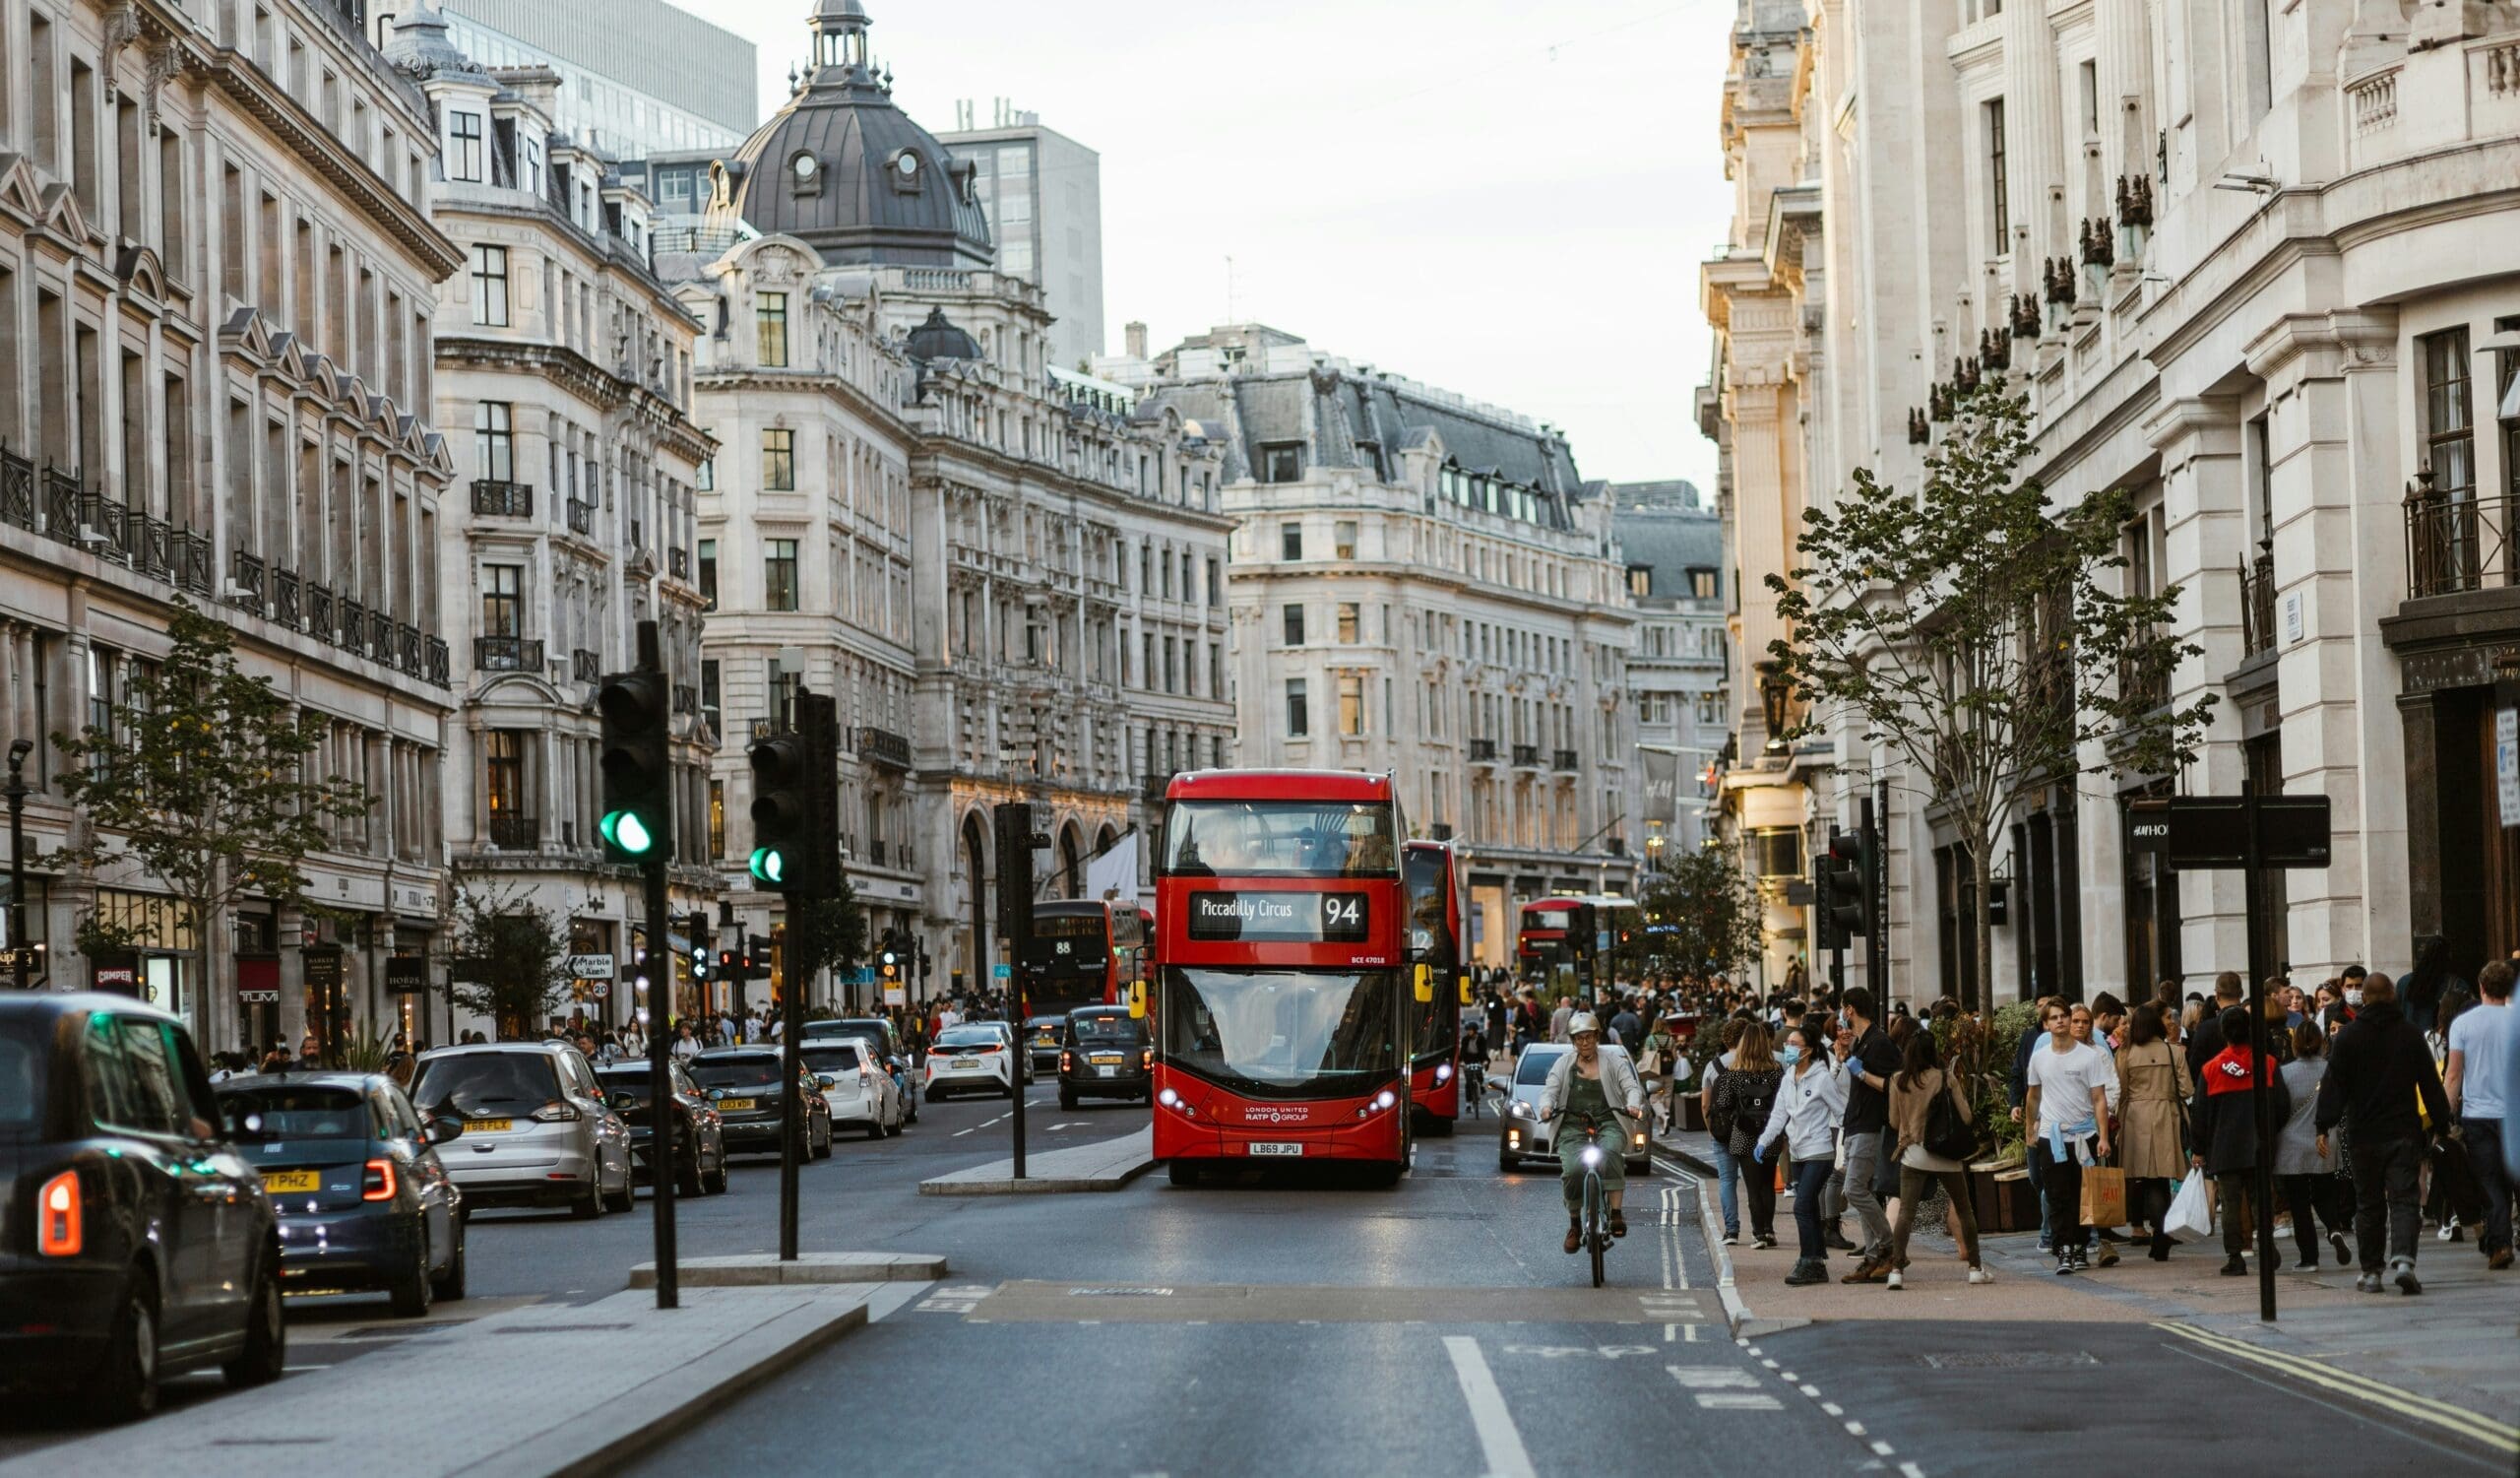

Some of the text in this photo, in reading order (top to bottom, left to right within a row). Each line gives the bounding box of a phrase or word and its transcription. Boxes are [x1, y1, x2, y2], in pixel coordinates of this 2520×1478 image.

[1201, 898, 1359, 925] Piccadilly Circus 94
[1055, 941, 1071, 954] 88
[580, 957, 610, 966] Marble
[97, 970, 132, 984] CAMPER
[239, 990, 279, 1002] TUMI
[1253, 1144, 1298, 1153] LB69 JPU
[278, 1174, 308, 1188] PHZ
